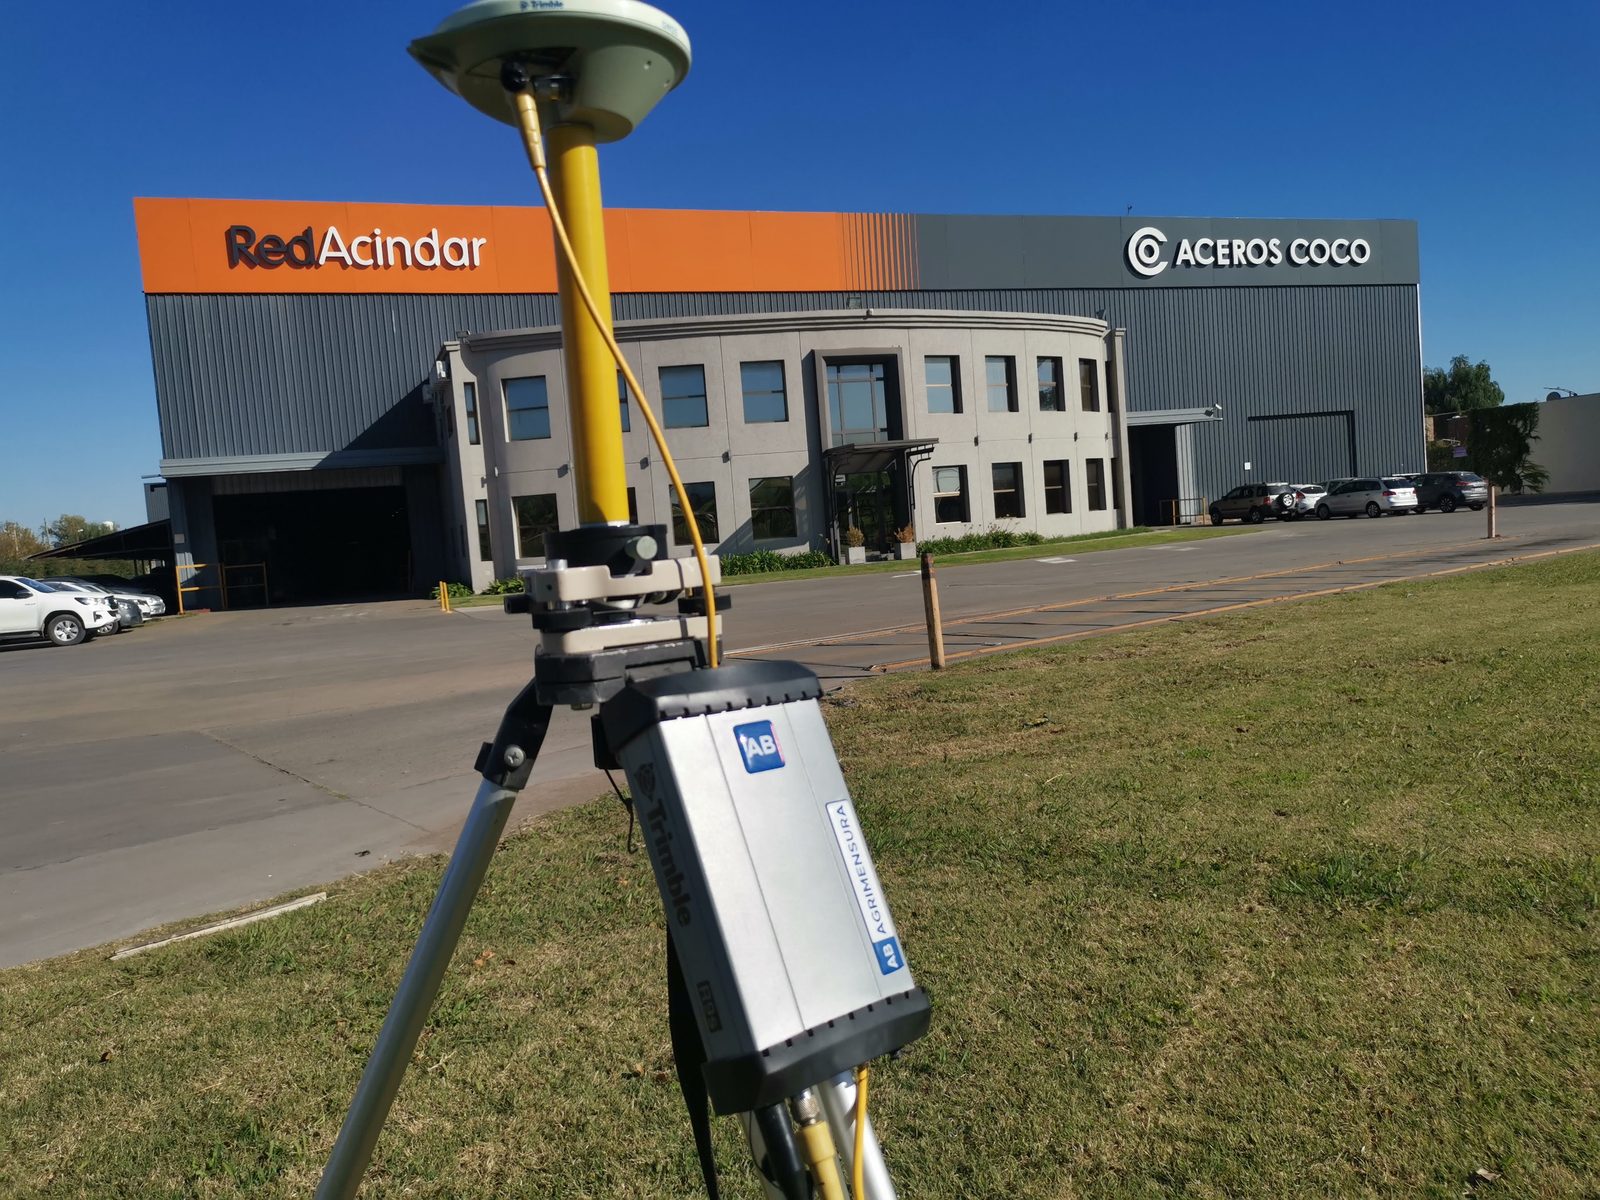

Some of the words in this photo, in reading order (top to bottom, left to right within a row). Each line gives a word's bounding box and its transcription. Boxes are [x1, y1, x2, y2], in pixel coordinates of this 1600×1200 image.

[530, 0, 564, 9] Trimble
[227, 225, 487, 268] RedAcindar
[1175, 237, 1283, 266] ACEROS
[1290, 237, 1371, 265] COCO
[645, 797, 692, 928] Trimble
[836, 804, 887, 934] AGRIMENSURA
[882, 944, 899, 969] AB
